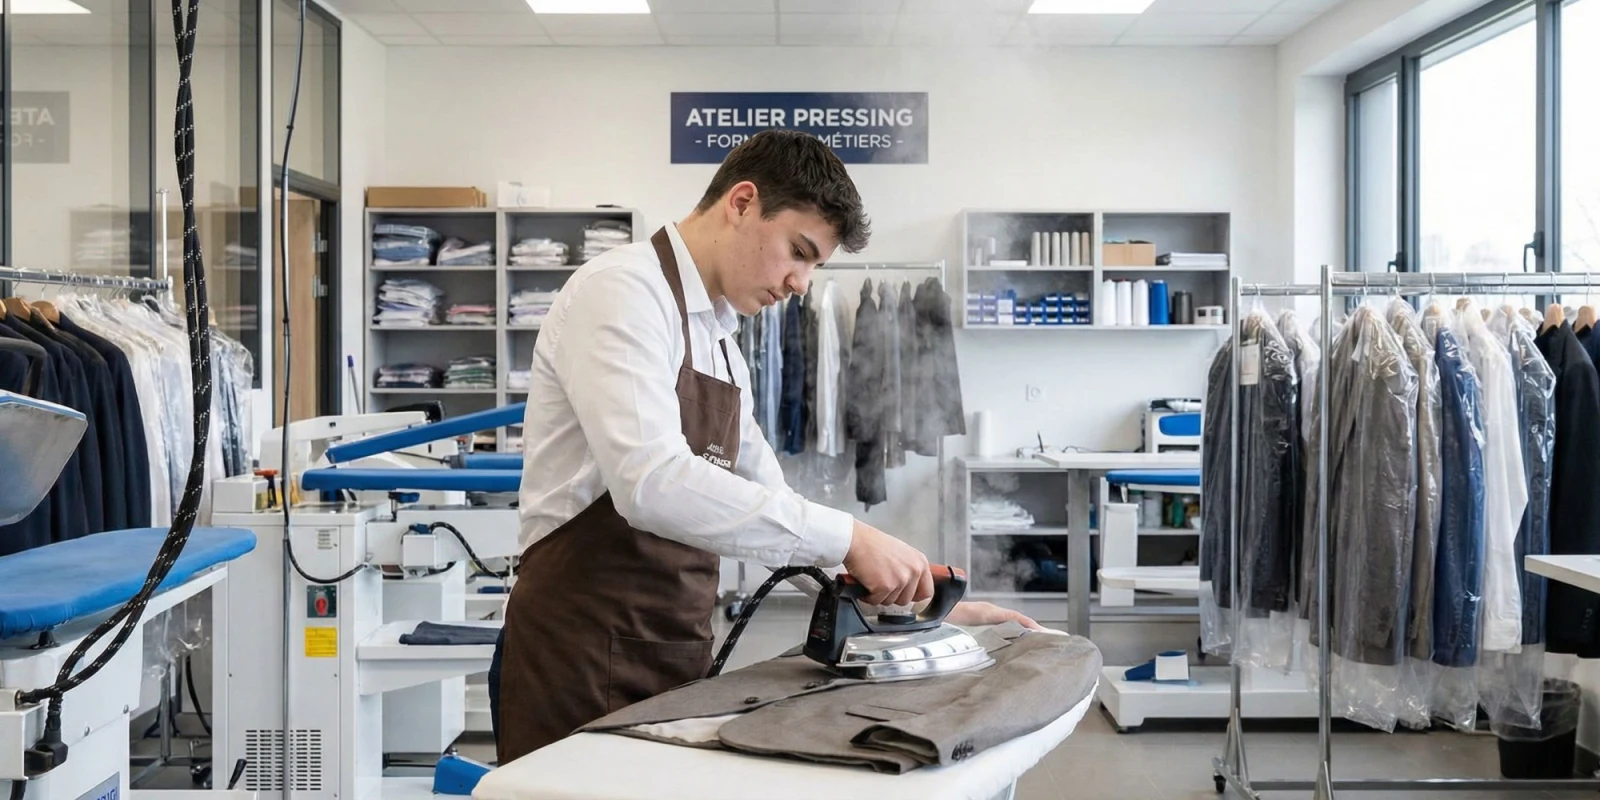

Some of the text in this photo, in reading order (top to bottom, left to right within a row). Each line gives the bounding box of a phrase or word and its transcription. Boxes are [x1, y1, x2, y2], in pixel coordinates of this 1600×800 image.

[685, 108, 913, 127] ATELIER PRESSING
[818, 131, 892, 149] MÉTIERS
